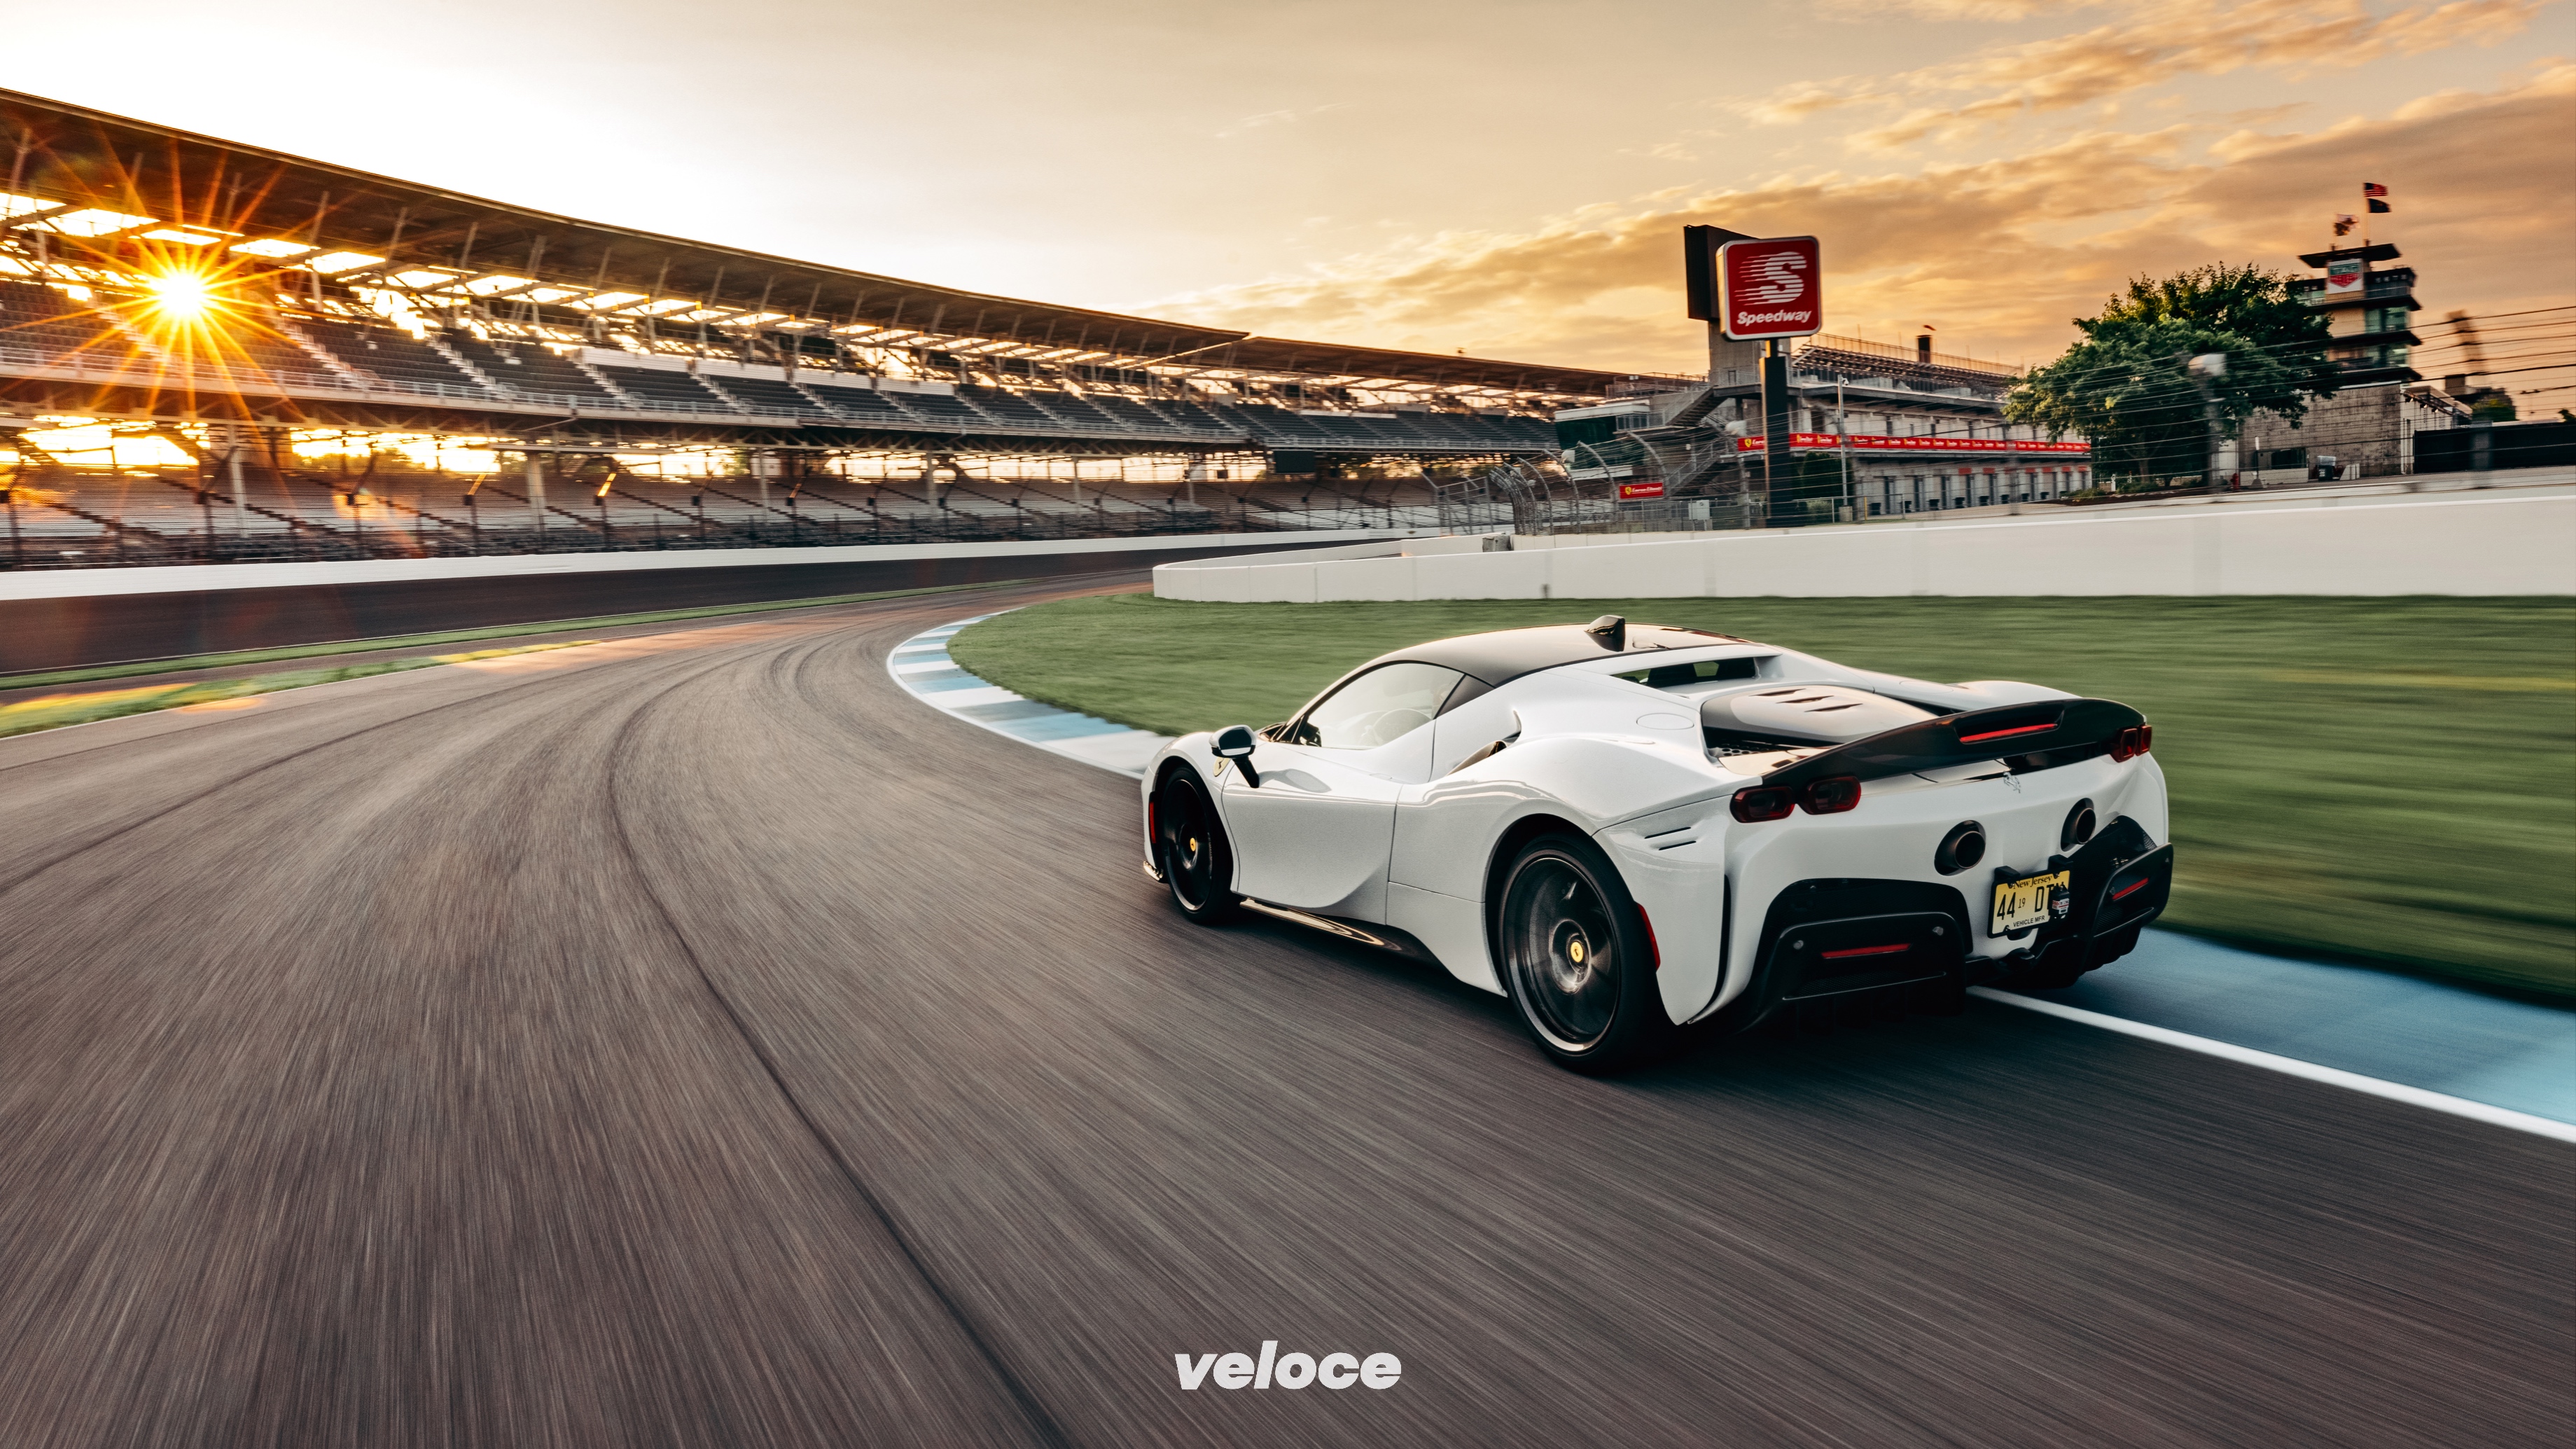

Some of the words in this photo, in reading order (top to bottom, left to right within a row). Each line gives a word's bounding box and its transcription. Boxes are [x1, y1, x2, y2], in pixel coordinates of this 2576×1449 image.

[1736, 310, 1812, 326] Speedway
[2014, 880, 2030, 889] New
[2030, 875, 2053, 888] Jersey
[1996, 892, 2017, 921] 44
[2018, 897, 2026, 909] 19
[2013, 917, 2034, 928] VEHICLE
[2035, 915, 2045, 924] MFR
